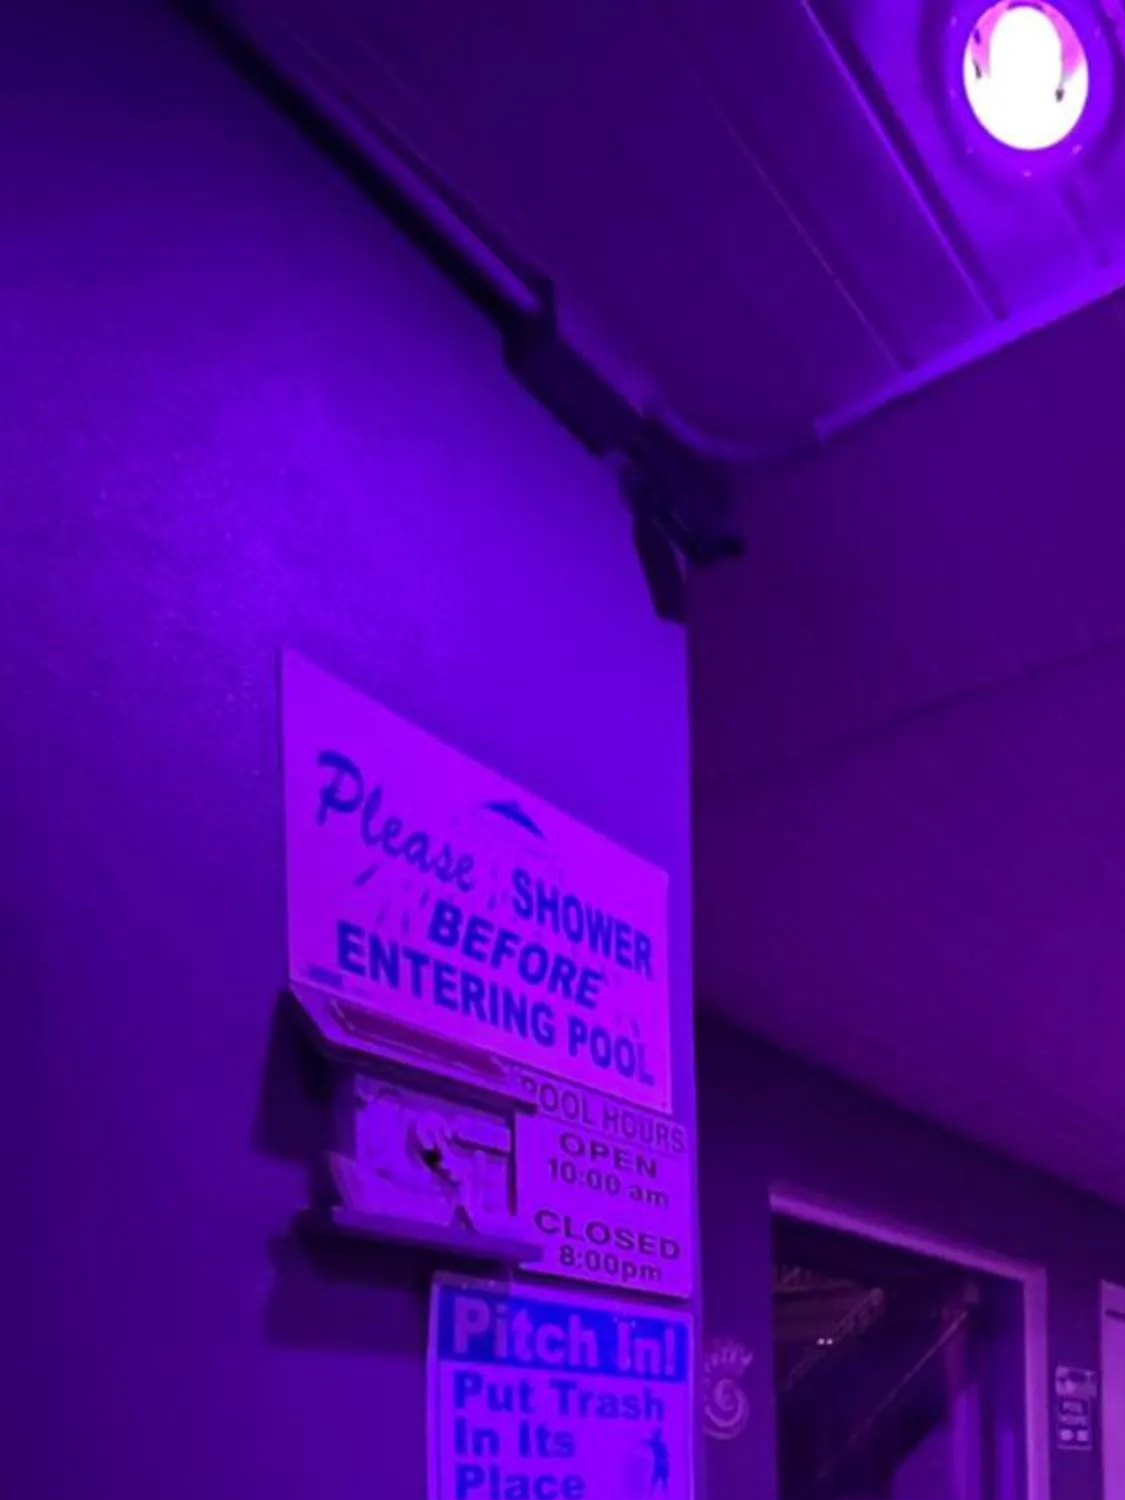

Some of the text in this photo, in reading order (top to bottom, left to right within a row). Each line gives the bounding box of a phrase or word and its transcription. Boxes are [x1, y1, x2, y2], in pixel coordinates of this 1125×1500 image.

[317, 750, 655, 981] Please SHOWER
[428, 900, 604, 1010] BEFORE
[336, 919, 656, 1087] ENTERING POOL
[603, 1104, 685, 1152] HOURS
[560, 1132, 657, 1178] OPEN
[548, 1158, 670, 1210] 10:00 am
[534, 1209, 681, 1260] CLOSED
[453, 1295, 676, 1377] Pitch In!
[453, 1371, 664, 1423] Put Trash
[453, 1416, 577, 1458] In Its
